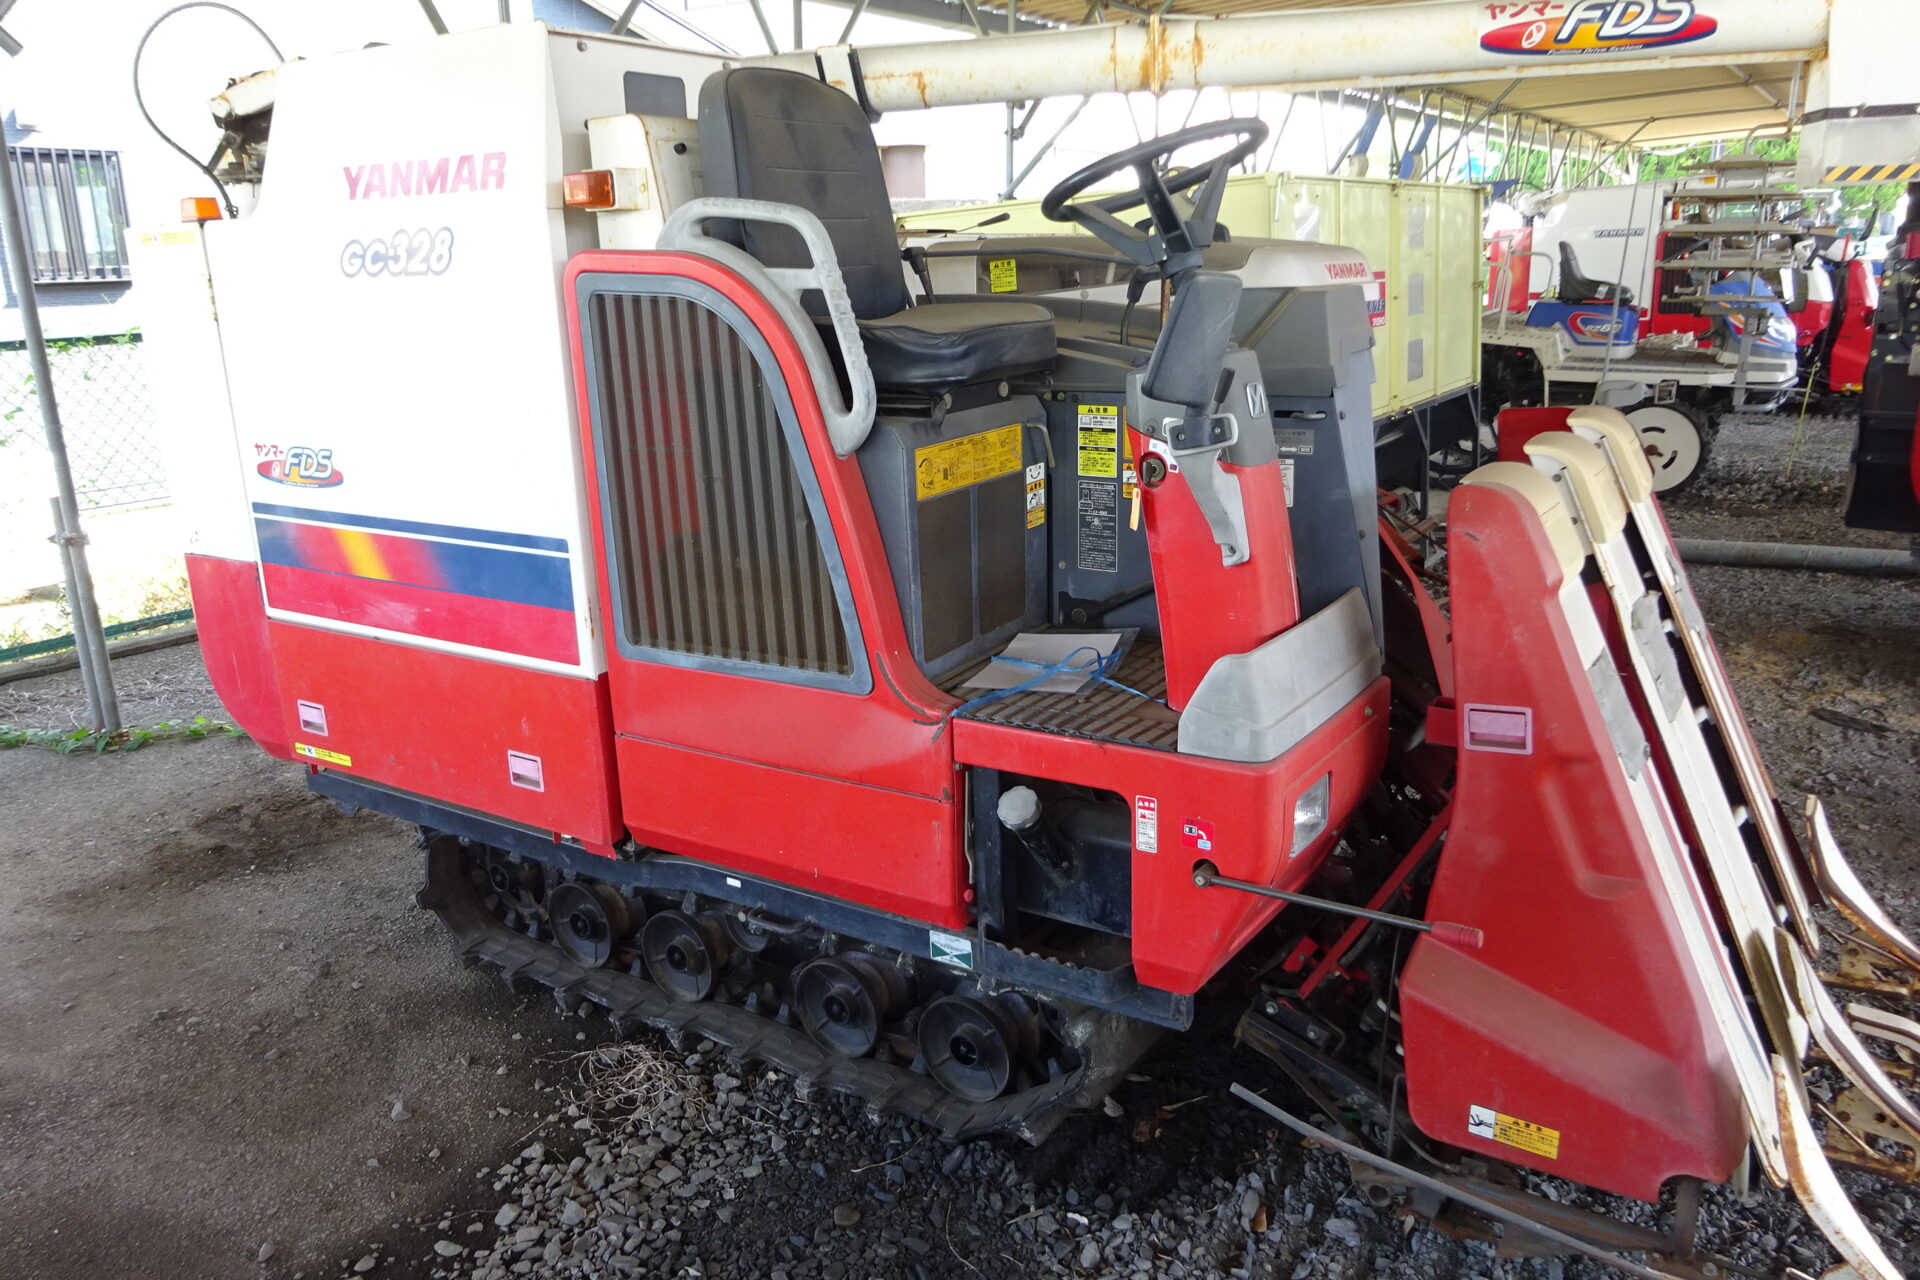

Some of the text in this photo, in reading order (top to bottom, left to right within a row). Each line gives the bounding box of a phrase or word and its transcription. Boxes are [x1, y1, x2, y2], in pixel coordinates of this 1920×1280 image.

[1484, 1, 1565, 20] ヤンマー
[1554, 0, 1695, 43] FDS
[1608, 45, 1643, 53] System
[343, 151, 507, 200] YANMAR
[341, 226, 454, 278] GC328
[1324, 262, 1367, 280] YANMAR
[255, 443, 284, 458] ヤンマー
[284, 446, 333, 481] FDS
